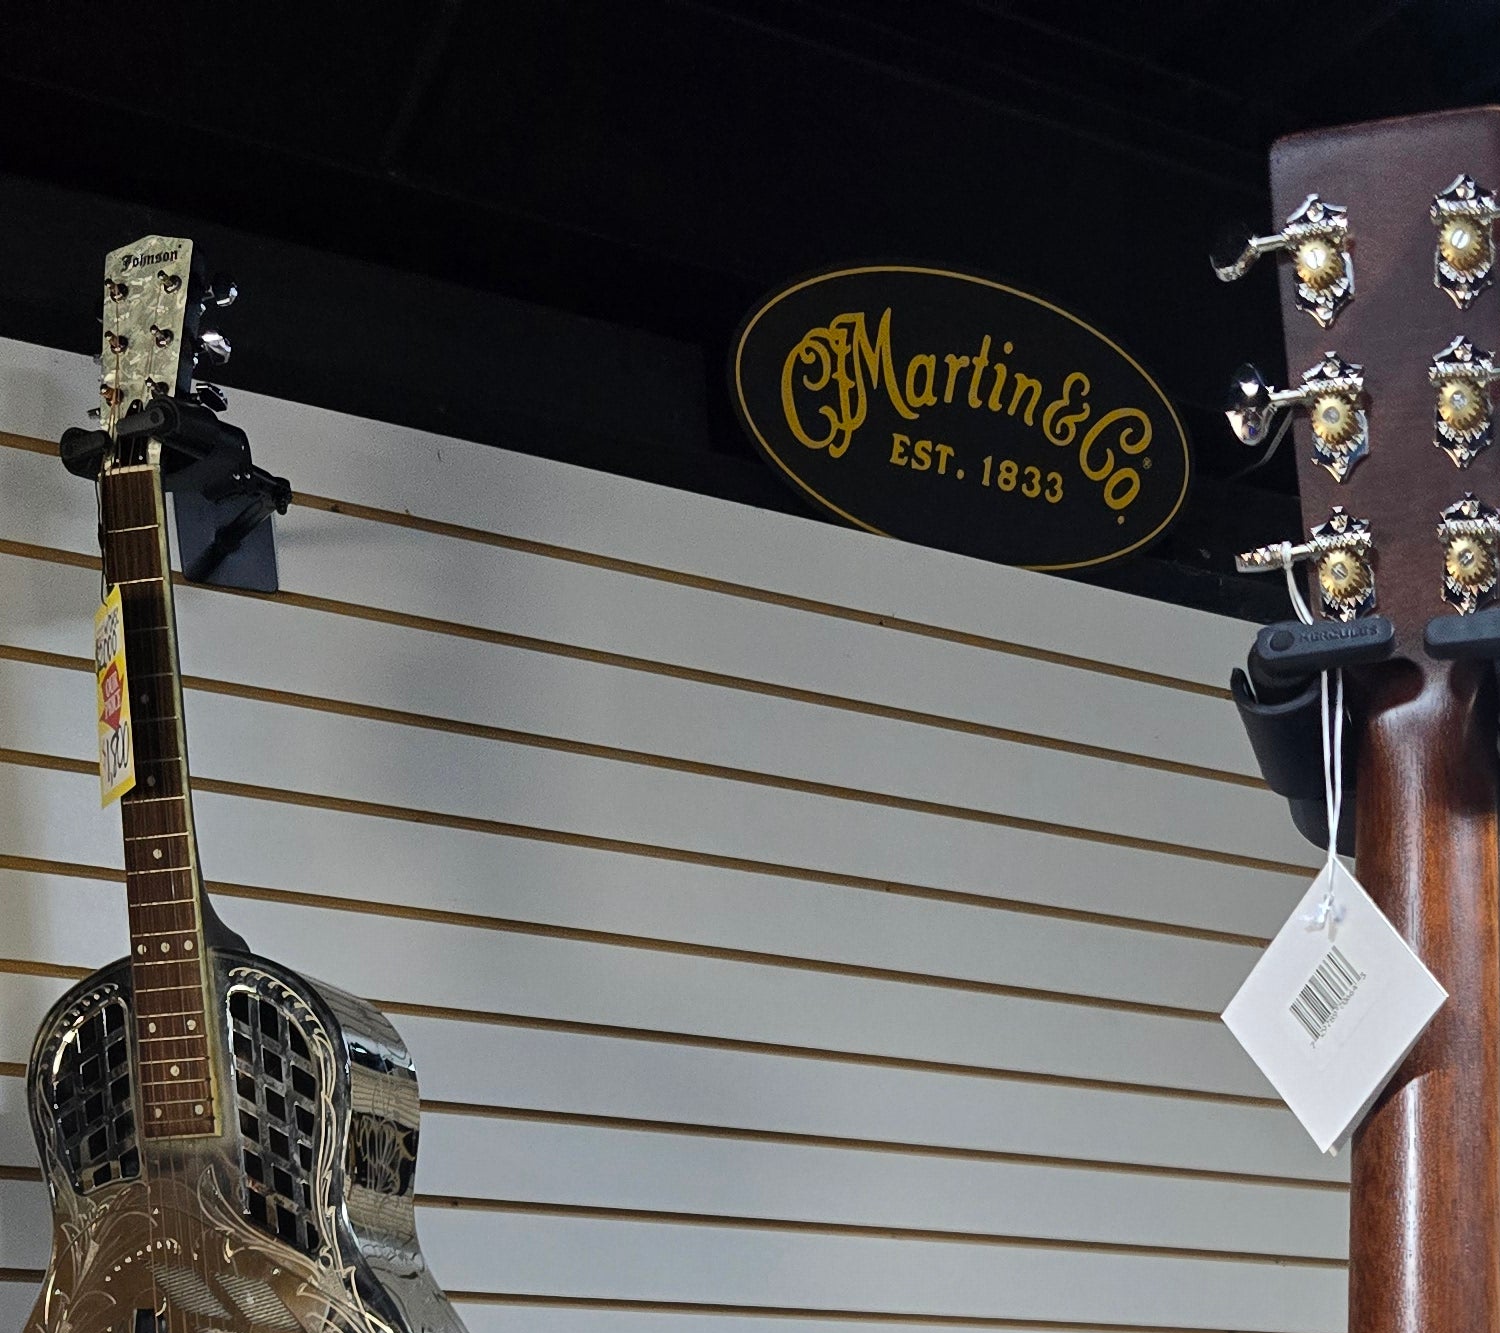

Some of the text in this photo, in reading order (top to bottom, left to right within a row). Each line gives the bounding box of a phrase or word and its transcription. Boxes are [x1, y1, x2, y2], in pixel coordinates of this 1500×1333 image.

[121, 249, 178, 272] Johnson
[832, 307, 1041, 427] Martin
[1043, 371, 1091, 447] &
[890, 433, 1064, 503] EST. 1833
